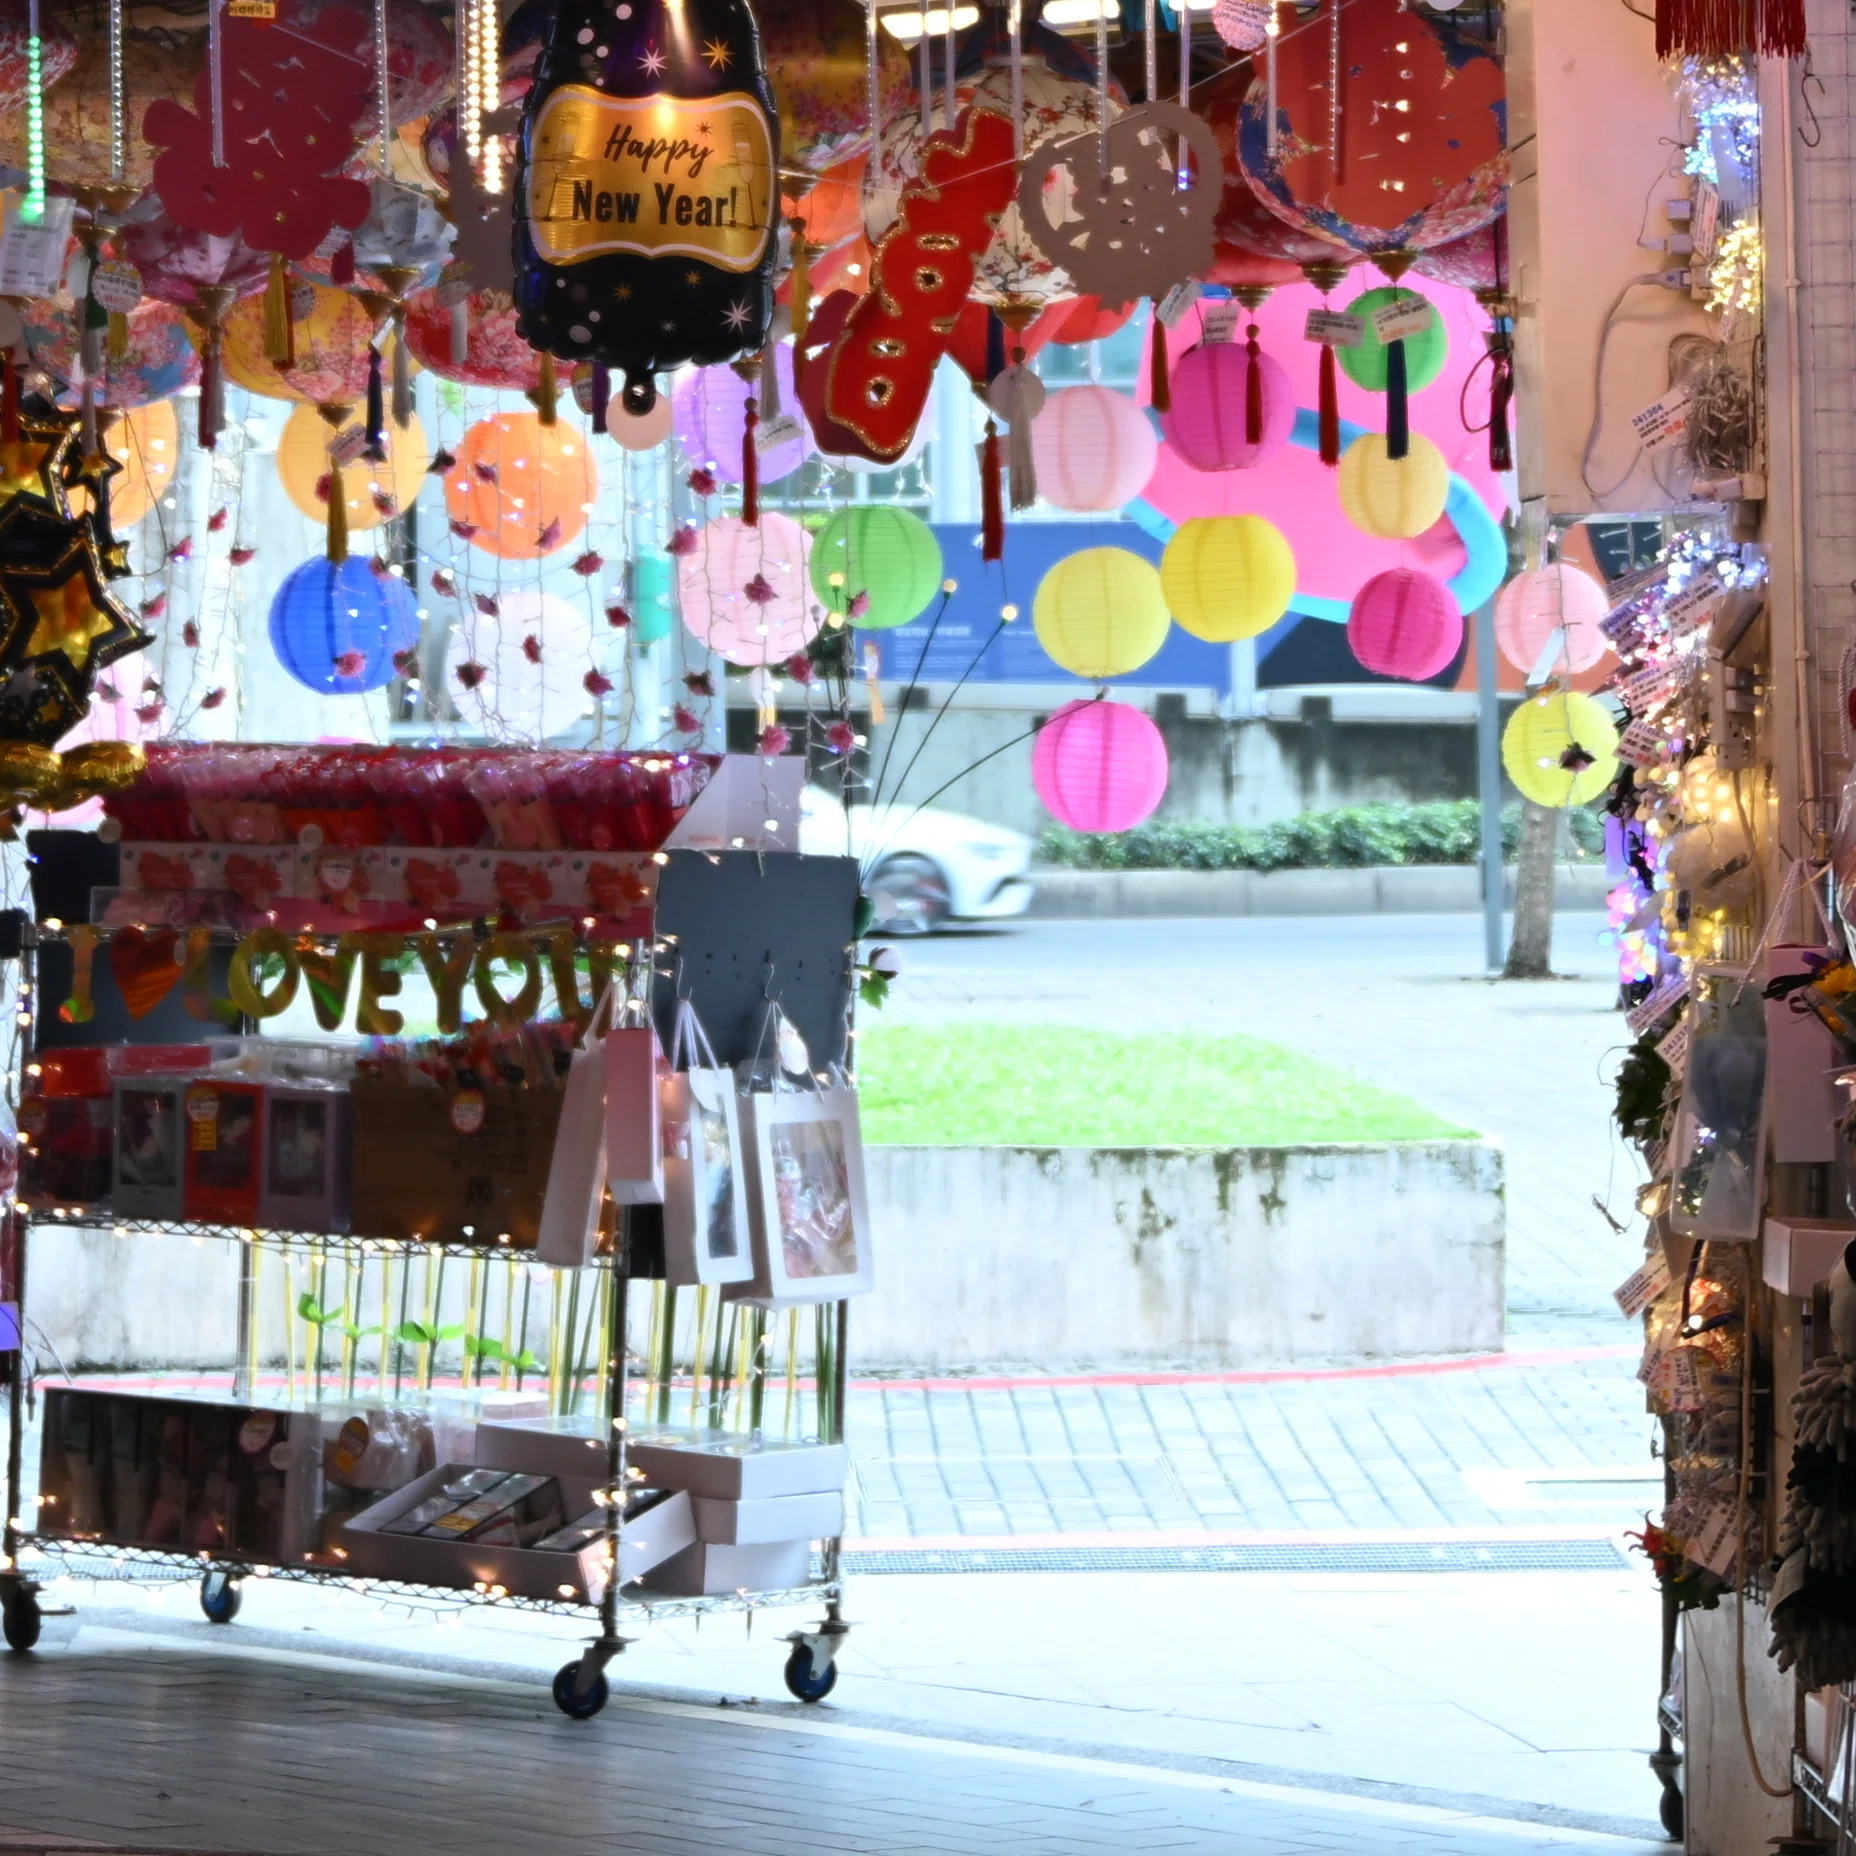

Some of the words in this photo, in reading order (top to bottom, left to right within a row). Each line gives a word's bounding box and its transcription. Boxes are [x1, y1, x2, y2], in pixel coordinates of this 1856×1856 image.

[603, 123, 716, 179] Happy
[571, 183, 641, 225] New
[654, 185, 739, 229] Year!
[182, 927, 407, 1035] LOVE
[417, 928, 614, 1036] YOU
